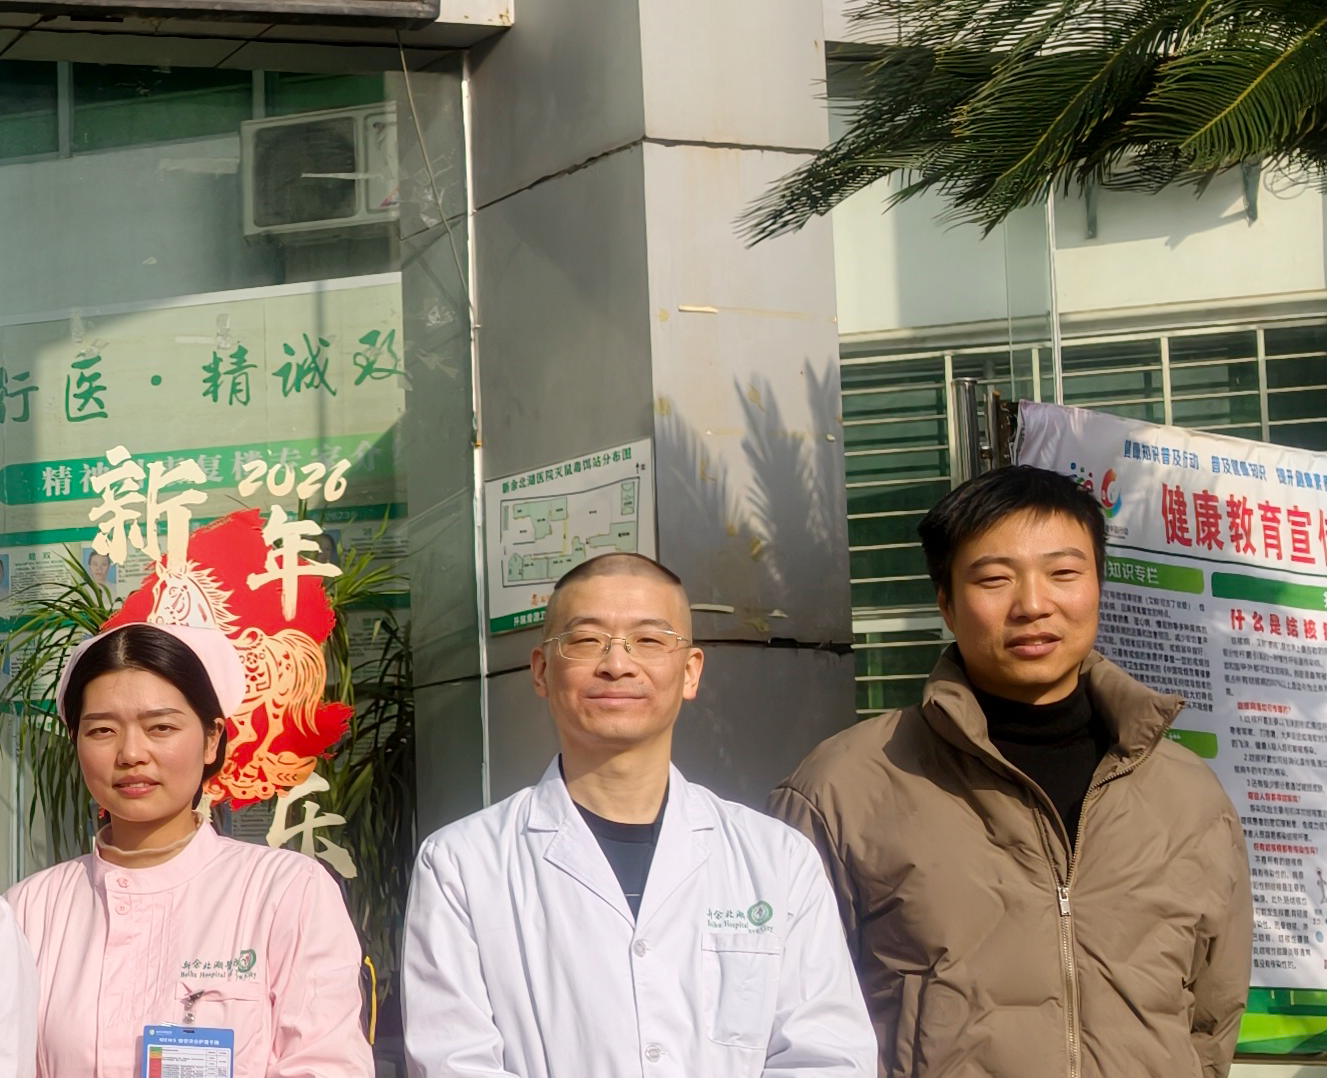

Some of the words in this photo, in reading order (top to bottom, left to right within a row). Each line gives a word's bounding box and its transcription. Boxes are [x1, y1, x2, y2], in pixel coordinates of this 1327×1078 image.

[238, 459, 352, 502] 2026
[1105, 560, 1159, 585] 知识专栏
